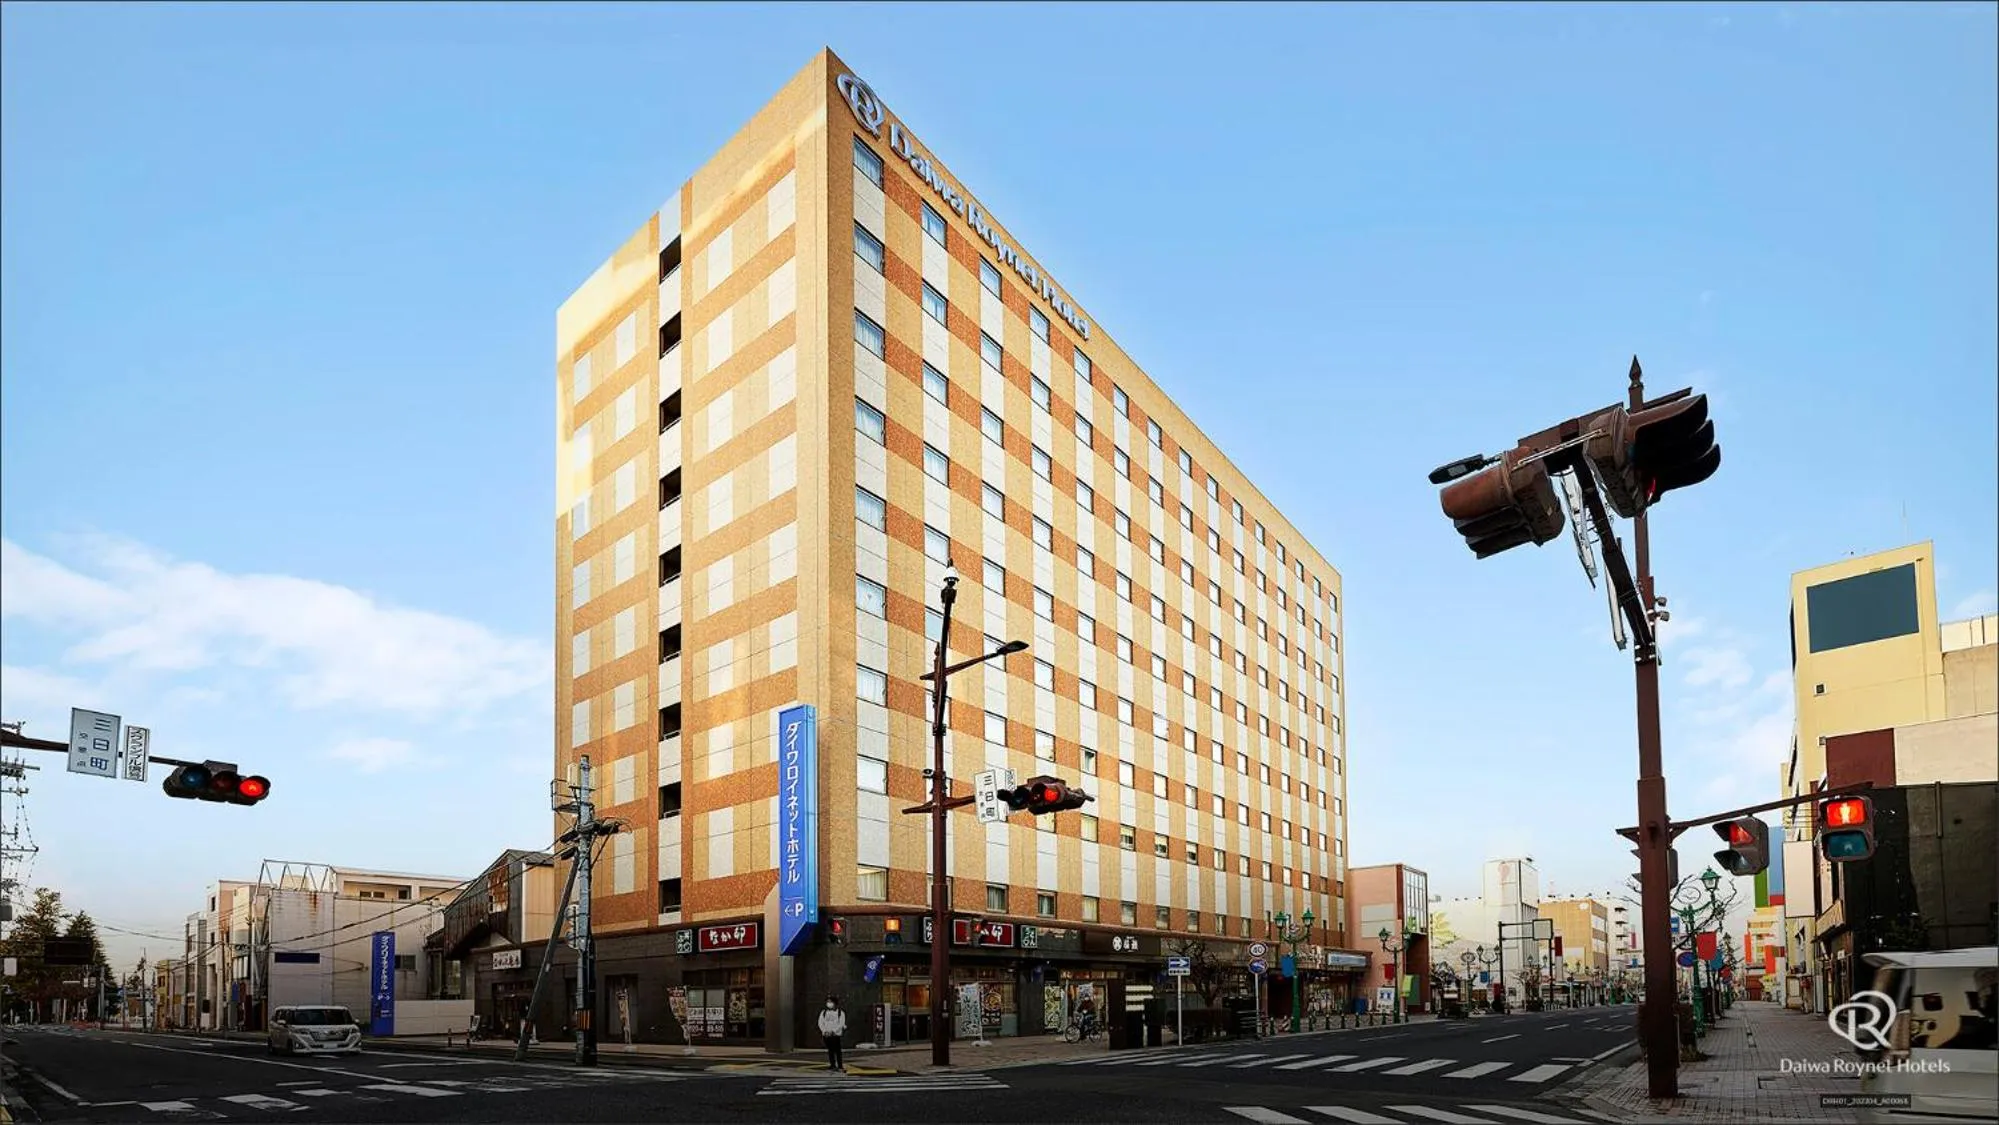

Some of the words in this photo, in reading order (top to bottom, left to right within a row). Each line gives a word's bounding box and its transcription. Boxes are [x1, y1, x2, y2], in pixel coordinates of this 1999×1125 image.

[890, 122, 963, 217] Daiwa
[1042, 277, 1091, 340] Hotel
[90, 718, 112, 770] 三日町
[786, 720, 802, 884] ダイワロイネットホテル
[984, 775, 995, 817] 三日町
[795, 903, 804, 917] P
[709, 926, 746, 945] なか卯
[1253, 946, 1263, 954] 40
